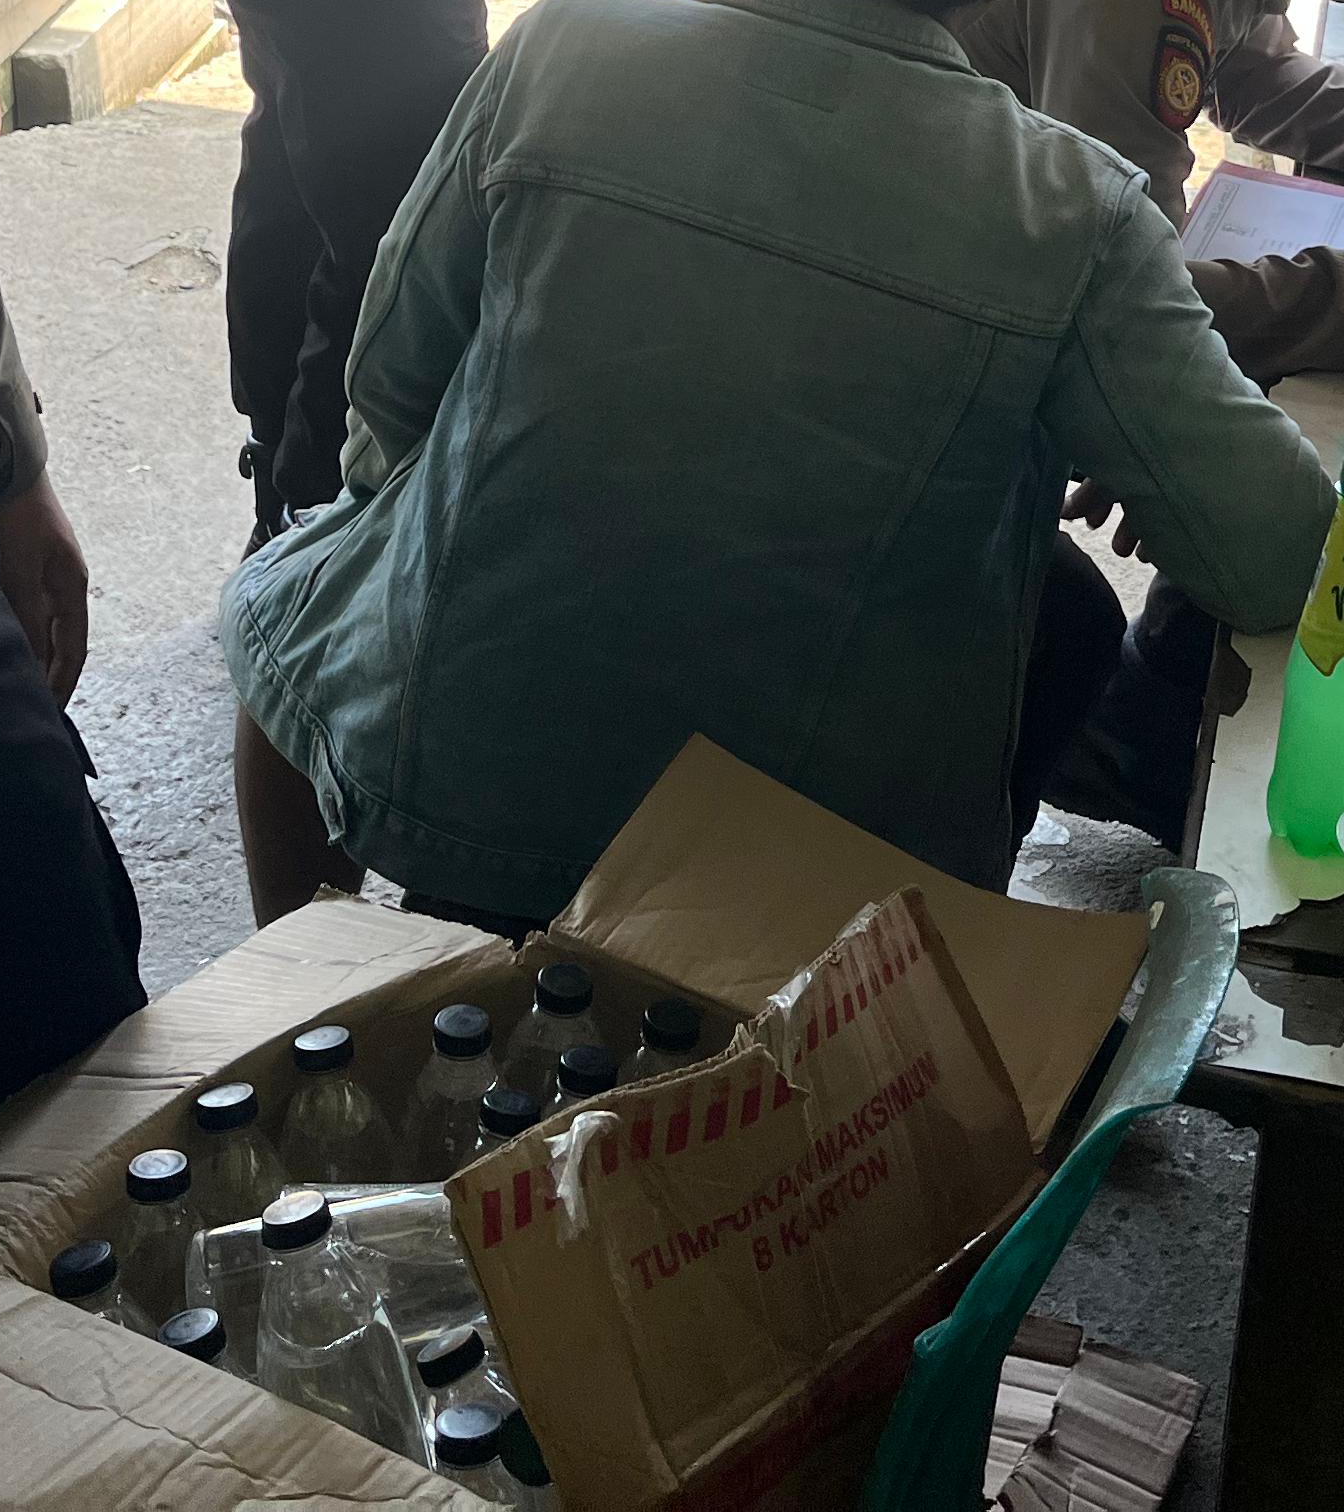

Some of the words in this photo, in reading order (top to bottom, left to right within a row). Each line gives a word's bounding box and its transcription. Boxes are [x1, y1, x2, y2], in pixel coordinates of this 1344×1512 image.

[630, 1150, 814, 1290] TUMPUKAN
[753, 1235, 774, 1272] 8
[777, 1145, 890, 1256] KARTON
